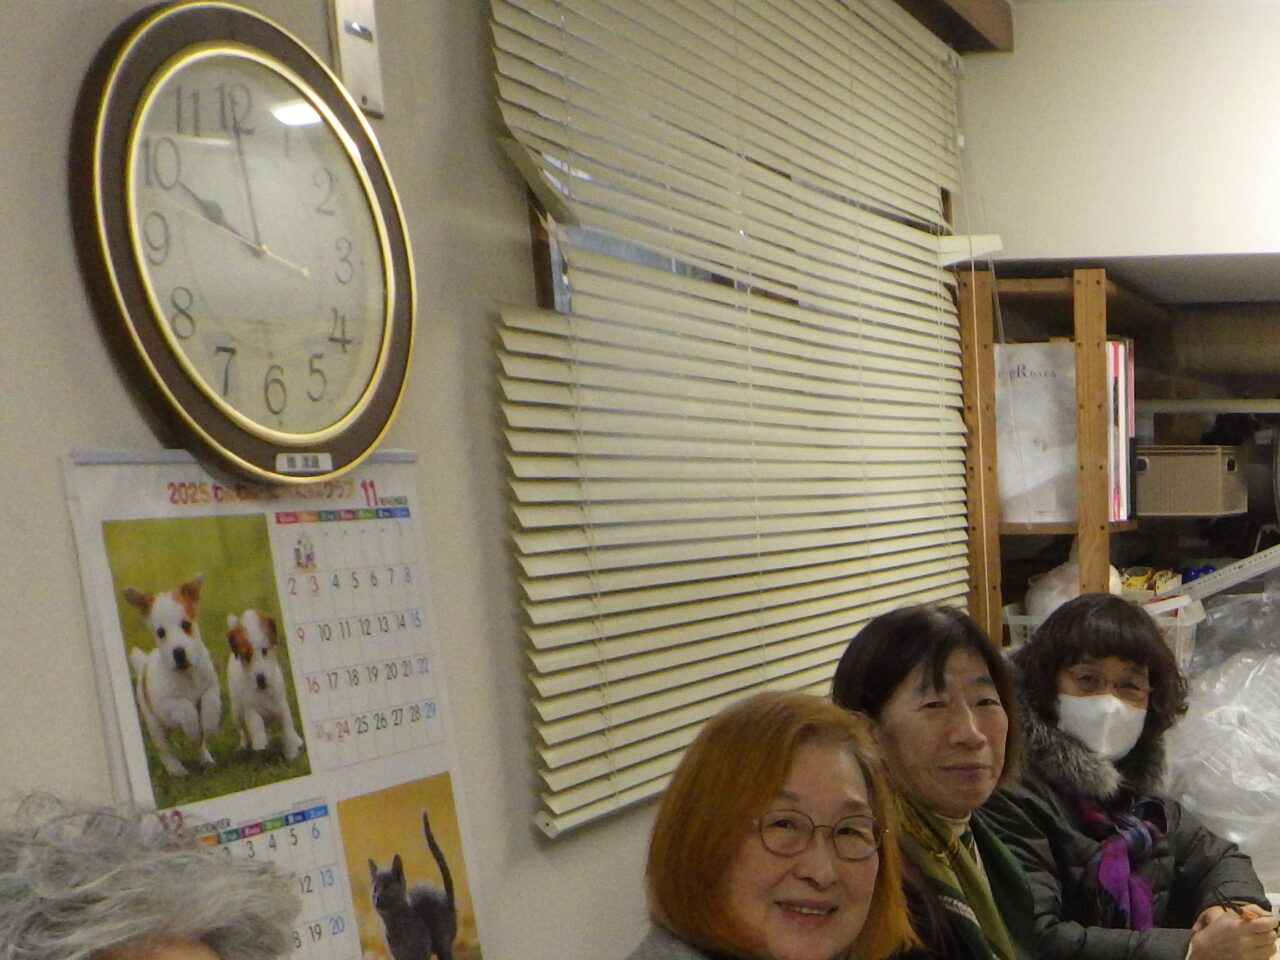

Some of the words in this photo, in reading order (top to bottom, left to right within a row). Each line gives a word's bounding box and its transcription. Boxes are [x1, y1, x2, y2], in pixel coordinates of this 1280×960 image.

[173, 85, 200, 136] 11
[215, 83, 254, 136] 12
[143, 137, 181, 191] 10
[313, 167, 335, 216] 2
[144, 210, 170, 266] 9
[335, 238, 353, 284] 3
[171, 286, 195, 339] 8
[329, 308, 352, 354] 4
[215, 346, 237, 396] 7
[264, 364, 287, 415] 6
[307, 354, 327, 402] 5
[167, 481, 210, 505] 2025
[360, 480, 378, 506] 11
[288, 577, 297, 595] 2
[310, 575, 319, 593] 3
[332, 573, 339, 590] 4
[351, 571, 359, 589] 5
[370, 569, 377, 586] 6
[387, 567, 394, 585] 7
[296, 627, 305, 645] 9
[318, 623, 331, 641] 10
[339, 621, 351, 638] 11
[358, 618, 371, 636] 12
[377, 616, 389, 633] 13
[395, 614, 406, 630] 14
[305, 675, 320, 694] 16
[326, 672, 338, 689] 17
[346, 669, 360, 686] 18
[366, 665, 379, 682] 19
[384, 662, 398, 680] 20
[401, 660, 413, 677] 21
[416, 656, 430, 674] 22
[335, 720, 350, 739] 24
[355, 716, 369, 734] 25
[373, 712, 388, 730] 26
[391, 708, 403, 726] 27
[408, 704, 421, 722] 28
[246, 840, 255, 858] 3
[268, 833, 277, 851] 4
[289, 827, 298, 846] 5
[311, 822, 320, 840] 6
[299, 875, 313, 893] 12
[320, 868, 334, 887] 13
[308, 923, 322, 942] 19
[329, 915, 345, 936] 20
